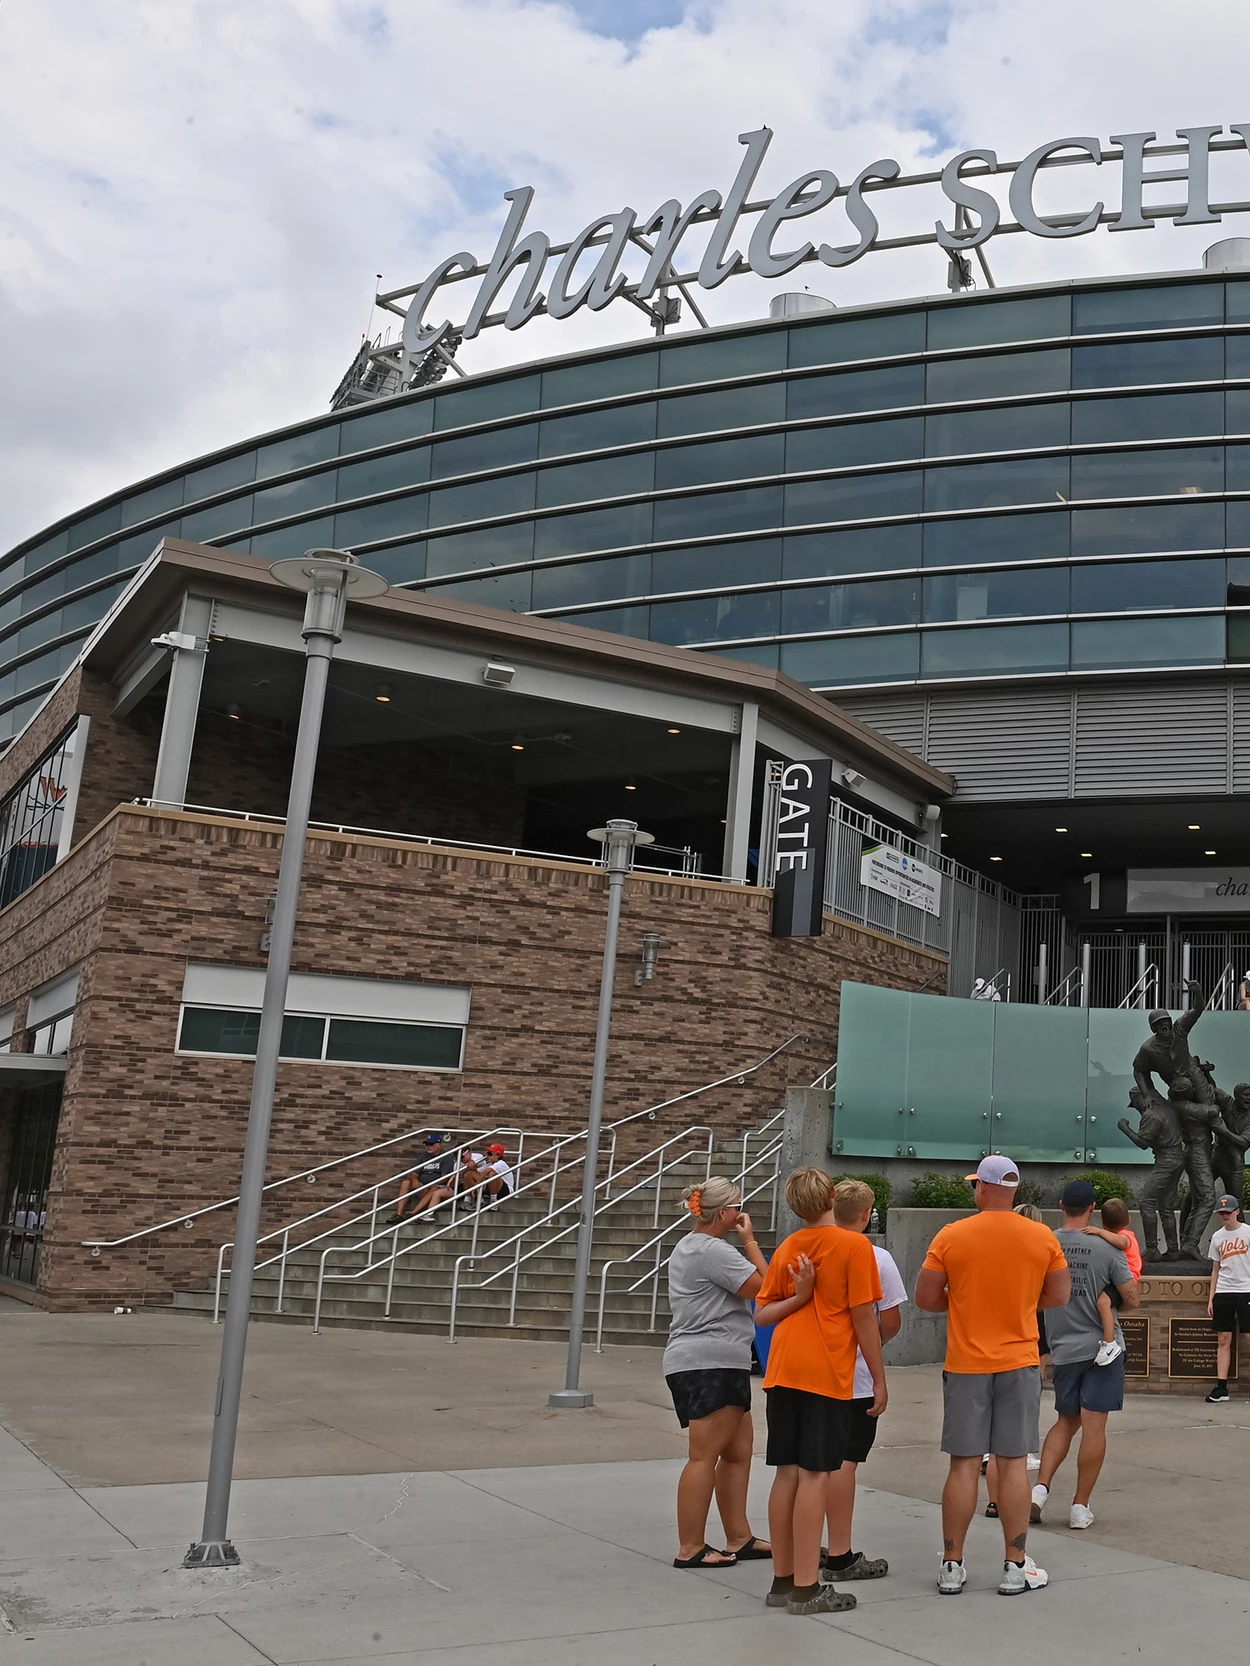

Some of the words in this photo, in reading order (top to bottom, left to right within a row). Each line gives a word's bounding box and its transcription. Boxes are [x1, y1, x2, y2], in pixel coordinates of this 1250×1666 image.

[402, 127, 900, 354] charles
[776, 763, 813, 871] GATE
[1083, 872, 1100, 910] 1
[1067, 1247, 1092, 1255] PARTNER
[1218, 1237, 1248, 1256] Vols
[1158, 1281, 1184, 1296] TO
